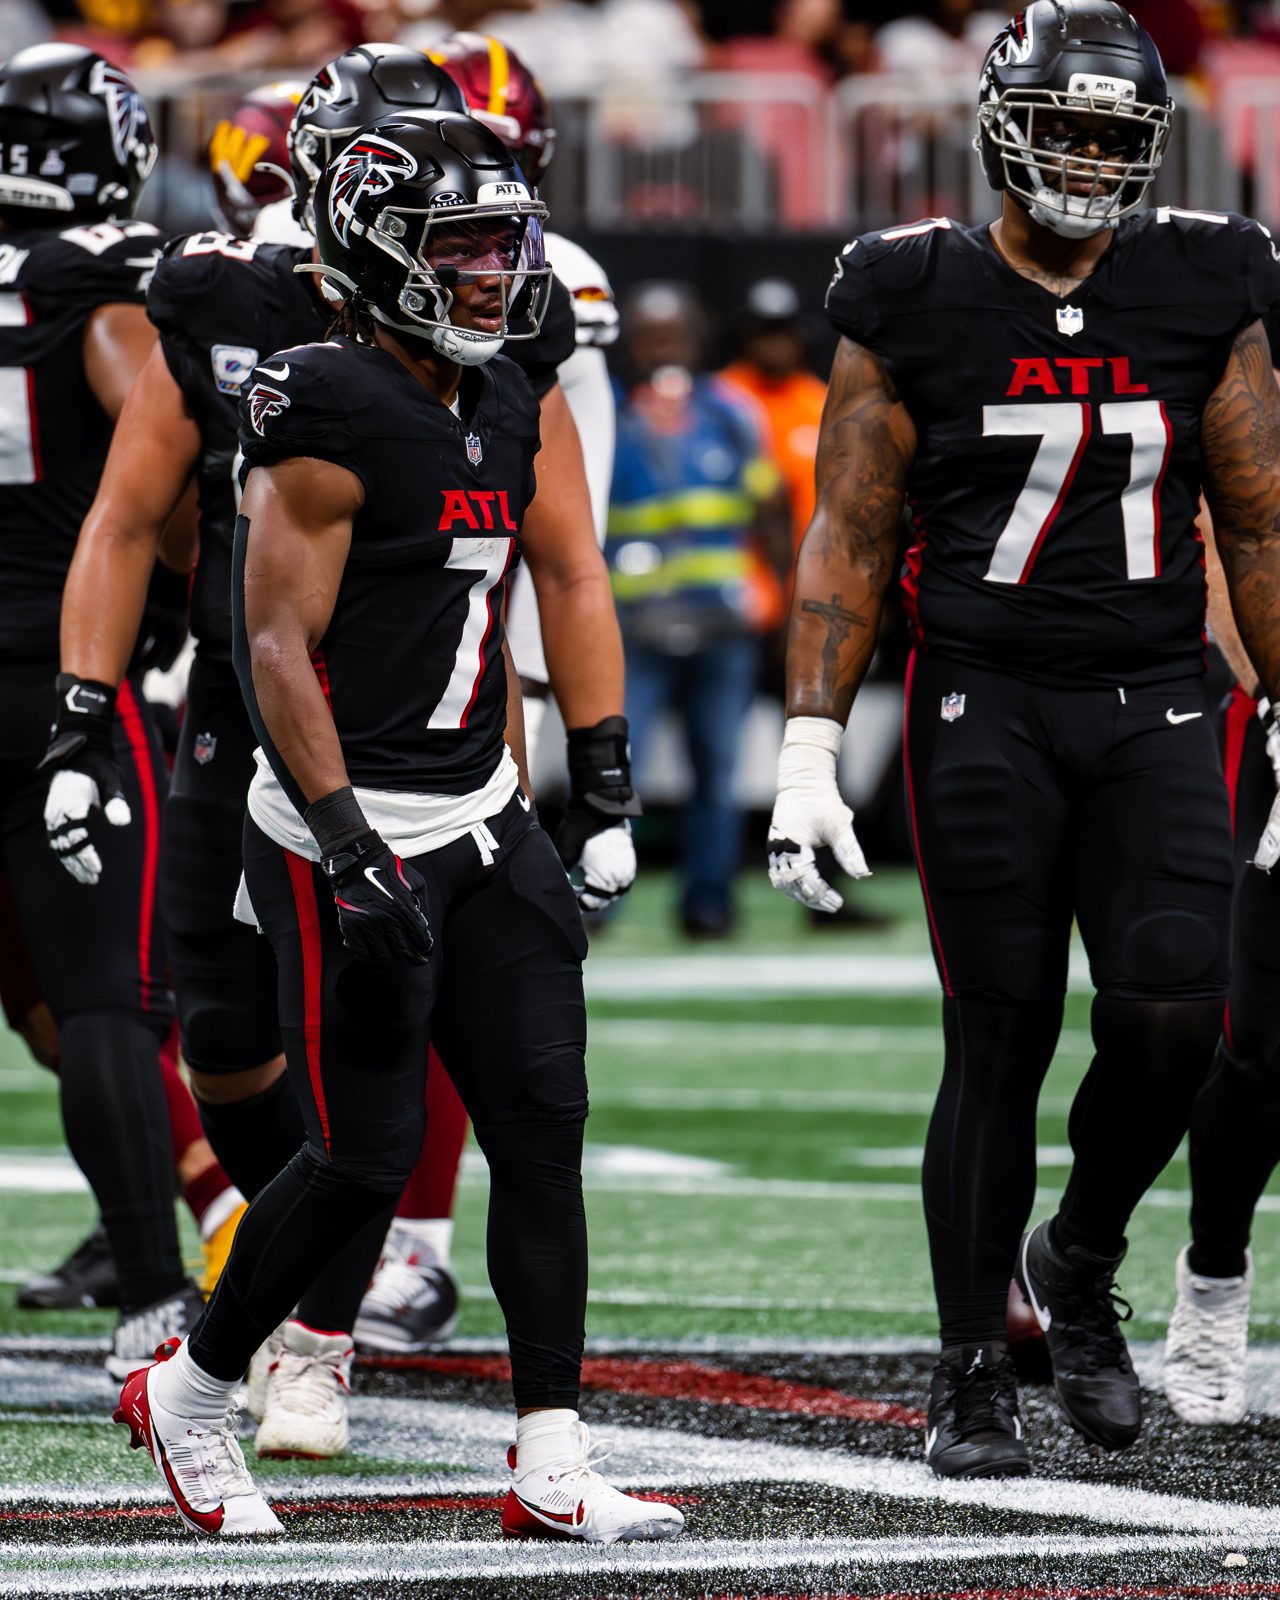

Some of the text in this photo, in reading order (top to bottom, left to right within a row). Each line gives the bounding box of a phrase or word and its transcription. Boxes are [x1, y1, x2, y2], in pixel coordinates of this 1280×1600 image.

[1094, 82, 1116, 92] ATL
[431, 199, 464, 208] OAKLEY
[496, 185, 521, 195] ATL
[1005, 356, 1150, 397] ATL
[437, 489, 518, 531] ATL
[982, 400, 1173, 585] 71
[426, 537, 515, 730] 7
